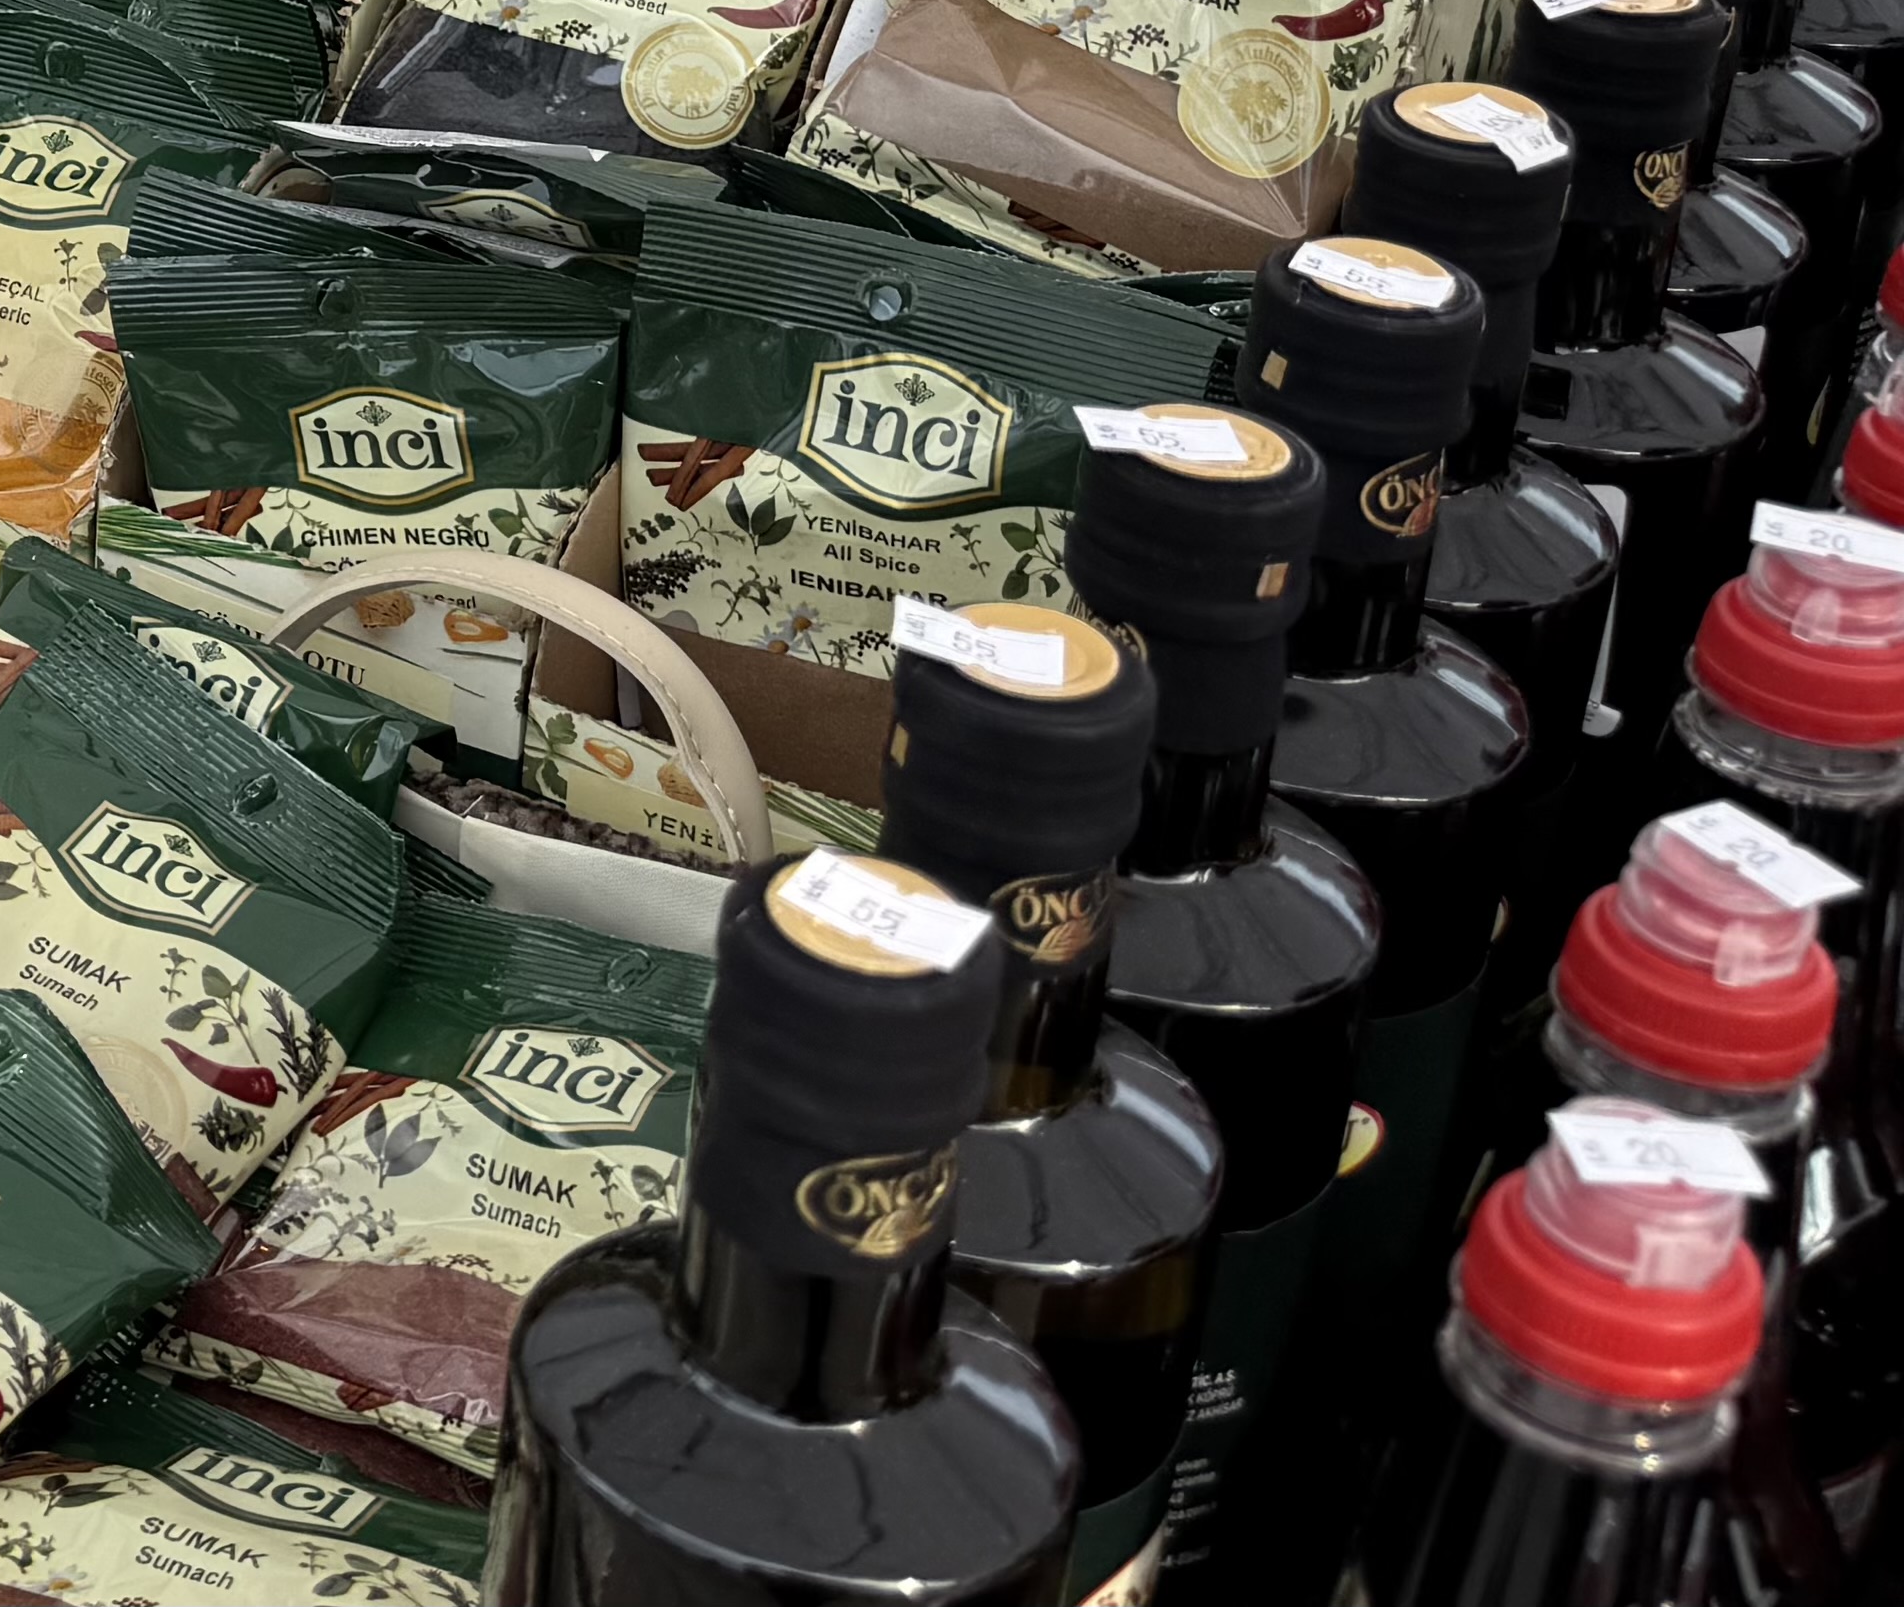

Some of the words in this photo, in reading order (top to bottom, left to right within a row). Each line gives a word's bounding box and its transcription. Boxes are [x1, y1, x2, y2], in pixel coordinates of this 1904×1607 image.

[312, 417, 454, 470] inci
[823, 379, 980, 480] inci
[300, 528, 396, 549] CHIMEN
[801, 514, 942, 554] YENİBAHAR
[823, 543, 854, 564] All
[859, 551, 921, 575] Spice
[302, 649, 366, 686] OTU
[84, 821, 230, 915] inci
[20, 962, 101, 1012] Sumach
[28, 935, 133, 994] SUMAK
[490, 1031, 644, 1115] inci
[466, 1153, 578, 1208] SUMAK
[470, 1193, 561, 1239] Sumach
[188, 1450, 363, 1523] inci
[136, 1545, 236, 1590] Sumach
[139, 1516, 270, 1568] SUMAK
